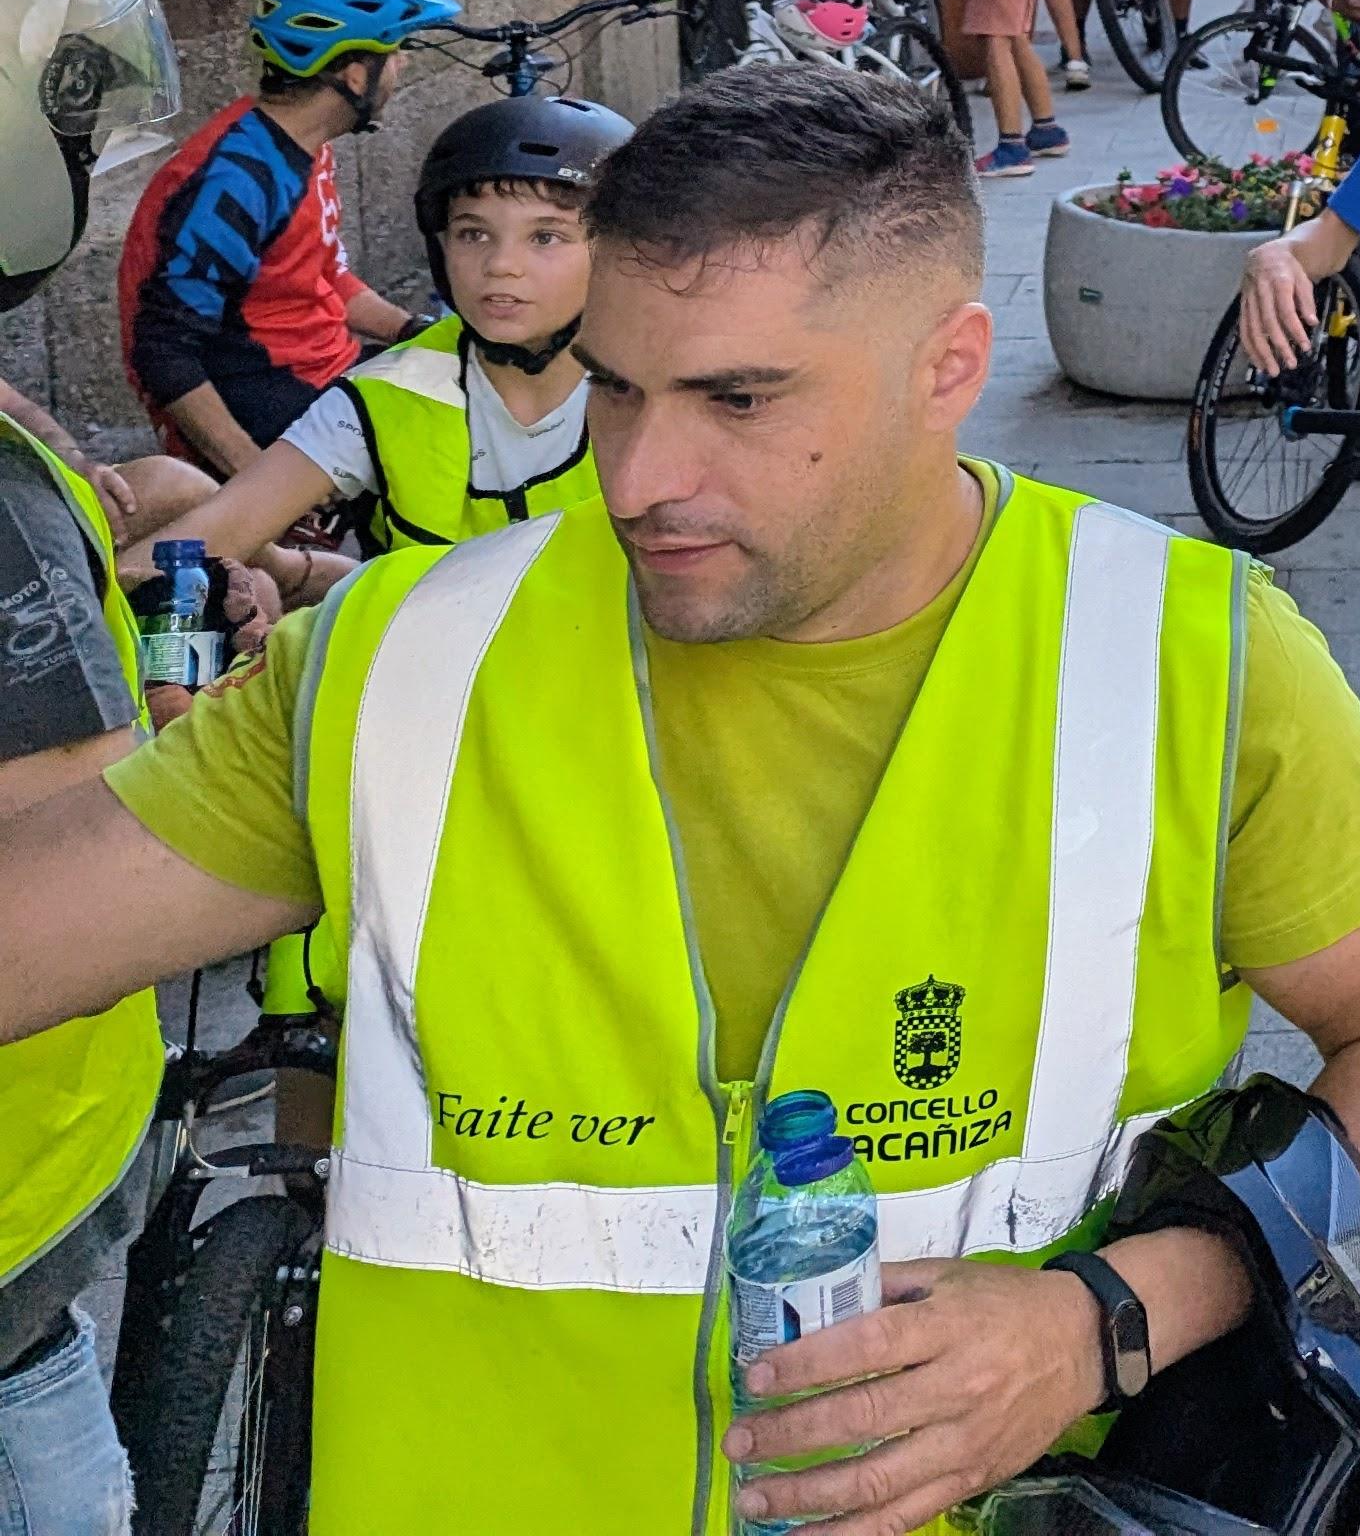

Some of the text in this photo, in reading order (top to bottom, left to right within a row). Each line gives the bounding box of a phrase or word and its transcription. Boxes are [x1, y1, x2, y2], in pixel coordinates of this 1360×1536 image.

[435, 1090, 656, 1148] Faite ver
[846, 1087, 998, 1126] CONCELLO
